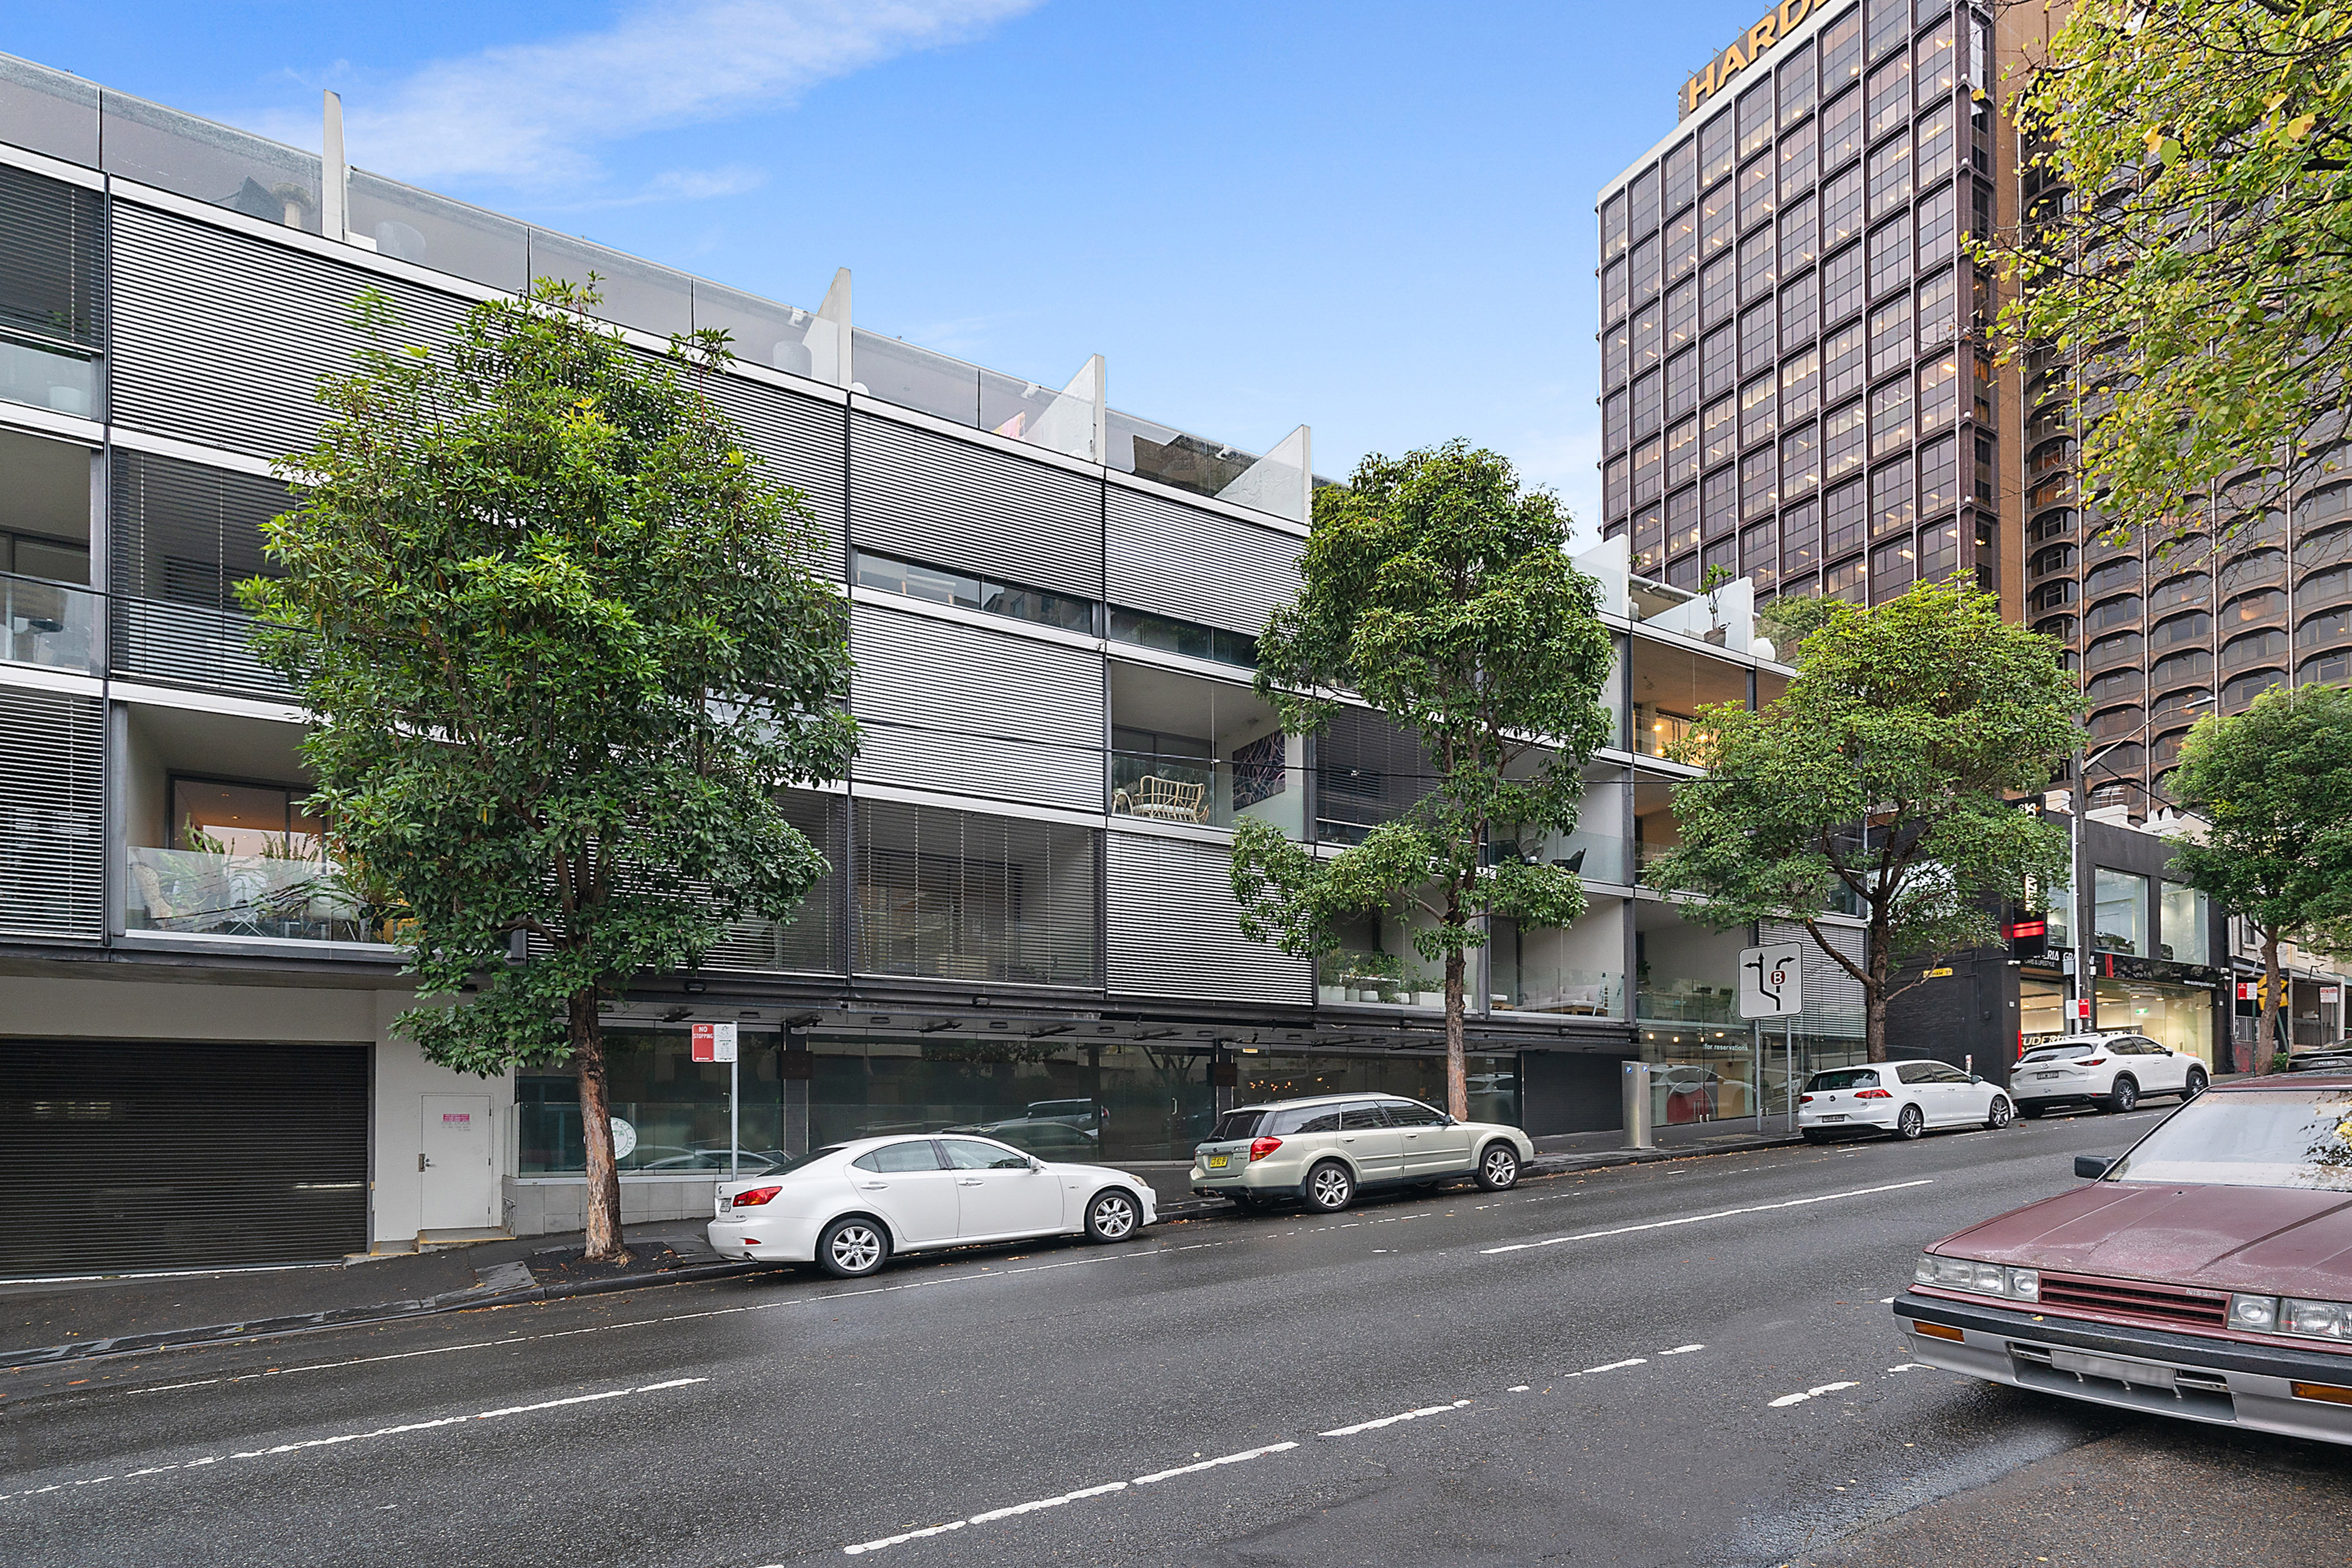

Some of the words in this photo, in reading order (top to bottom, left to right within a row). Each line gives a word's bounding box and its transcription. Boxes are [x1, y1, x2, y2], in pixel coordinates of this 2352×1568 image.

[1688, 0, 1827, 112] HARD
[1773, 972, 1782, 984] B
[2186, 1289, 2222, 1298] NISSAN
